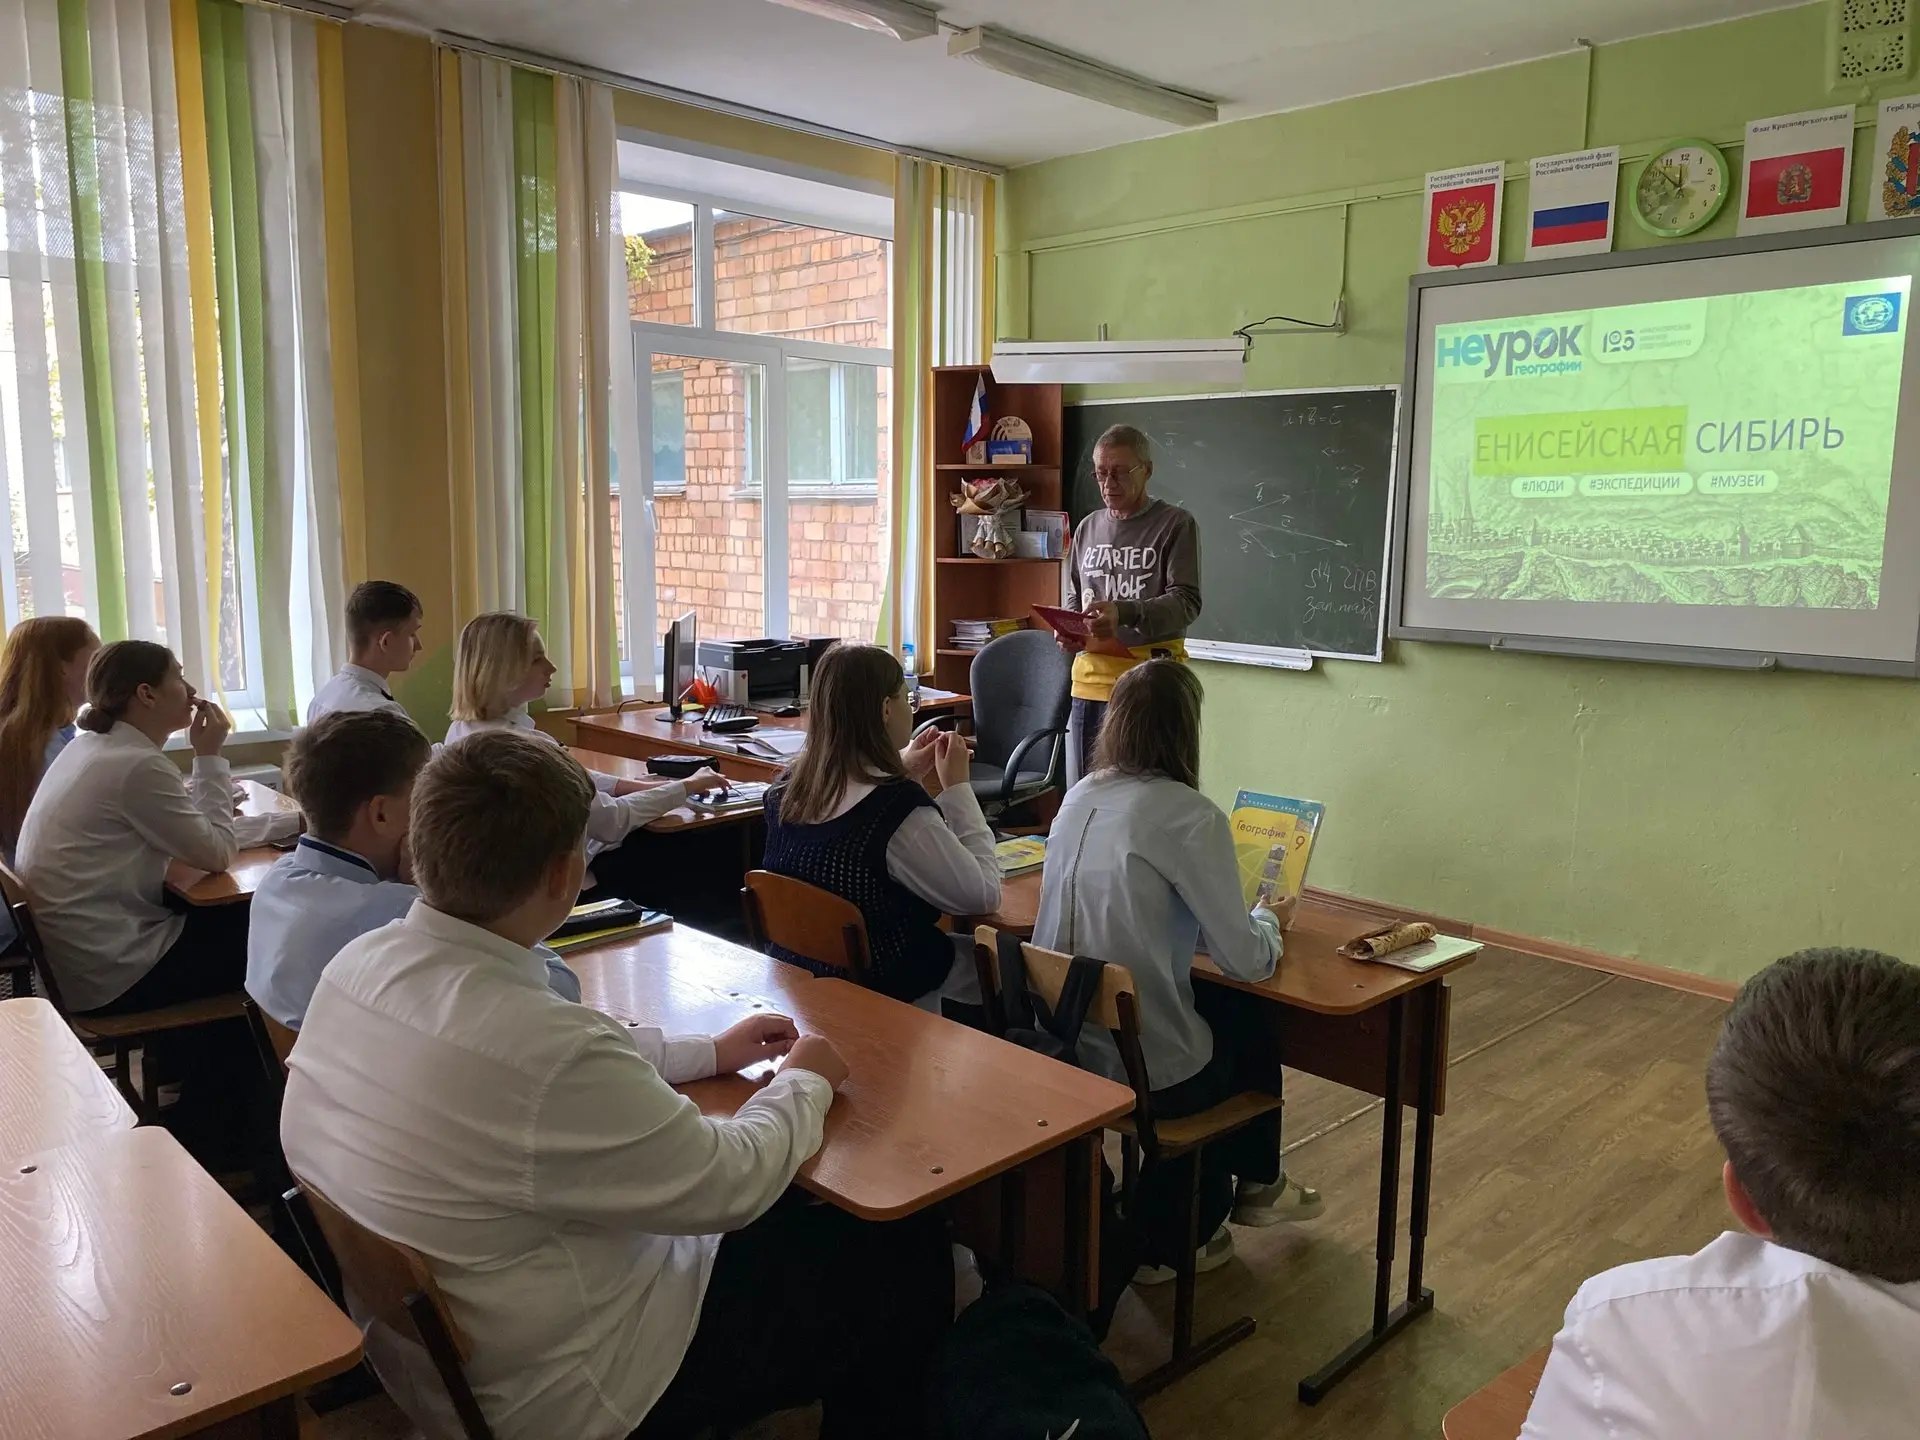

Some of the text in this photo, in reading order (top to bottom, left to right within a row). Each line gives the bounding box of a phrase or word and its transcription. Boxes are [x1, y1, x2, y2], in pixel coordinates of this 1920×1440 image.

[1752, 112, 1848, 134] Флаг Красноярского края
[1535, 152, 1613, 169] Государственный флаг
[1665, 158, 1673, 168] 11
[1680, 152, 1690, 161] 12
[1430, 165, 1500, 182] Государственный герб
[1535, 160, 1613, 177] Российской Федерации
[1707, 167, 1714, 176] 2
[1430, 174, 1500, 190] Российской Федерации
[1709, 184, 1716, 192] 3
[1671, 216, 1678, 225] 6
[1437, 325, 1583, 378] неурок
[1514, 359, 1582, 377] географии
[1476, 416, 1845, 463] ЕНИСЕЙСКАЯ СИБИРЬ
[1520, 474, 1765, 493] #ЛЮДИ #ЭКСПЕДИЦИИ #МУЗЕИ
[1081, 543, 1157, 571] RETARTED
[1236, 820, 1287, 840] География
[1295, 835, 1306, 851] 9
